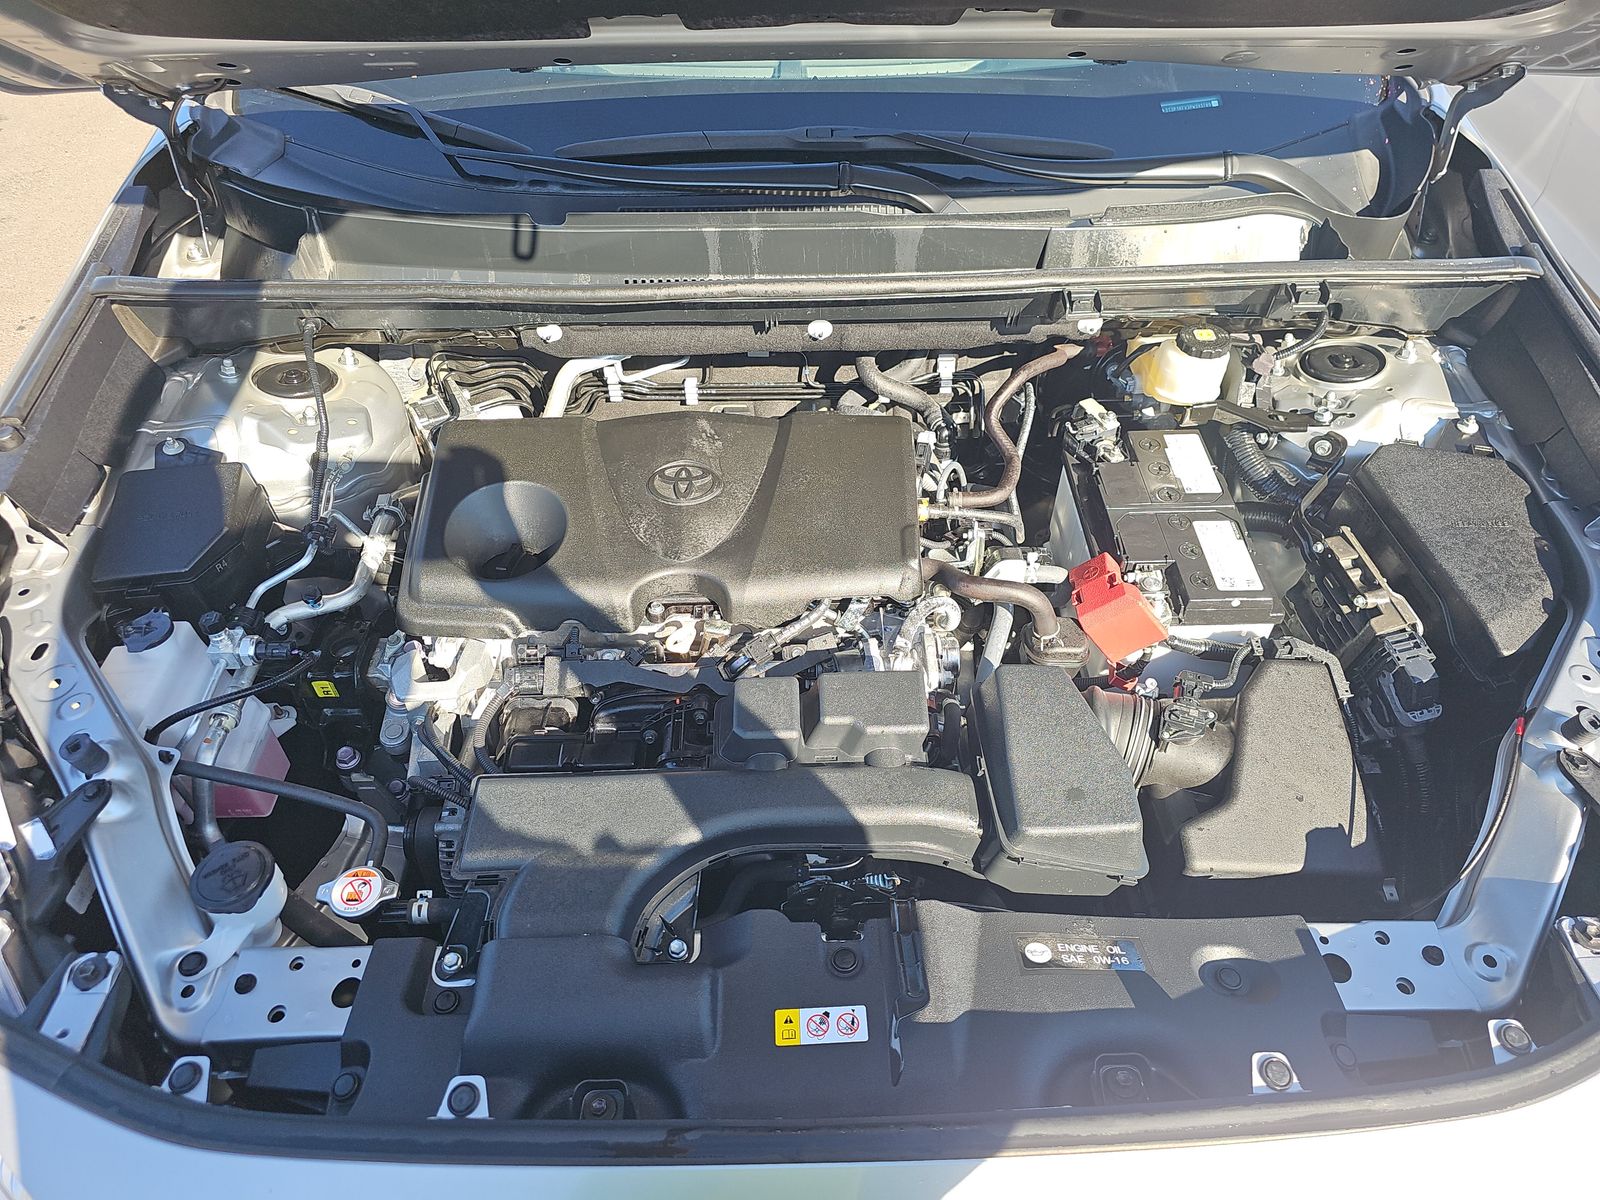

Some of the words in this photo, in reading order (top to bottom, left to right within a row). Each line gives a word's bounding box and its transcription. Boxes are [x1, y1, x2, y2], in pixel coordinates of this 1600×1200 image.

[215, 559, 227, 572] R4
[1057, 943, 1100, 954] ENGINE
[1106, 945, 1126, 955] OIL
[1061, 954, 1086, 964] SAE
[1093, 956, 1129, 965] 0W-16
